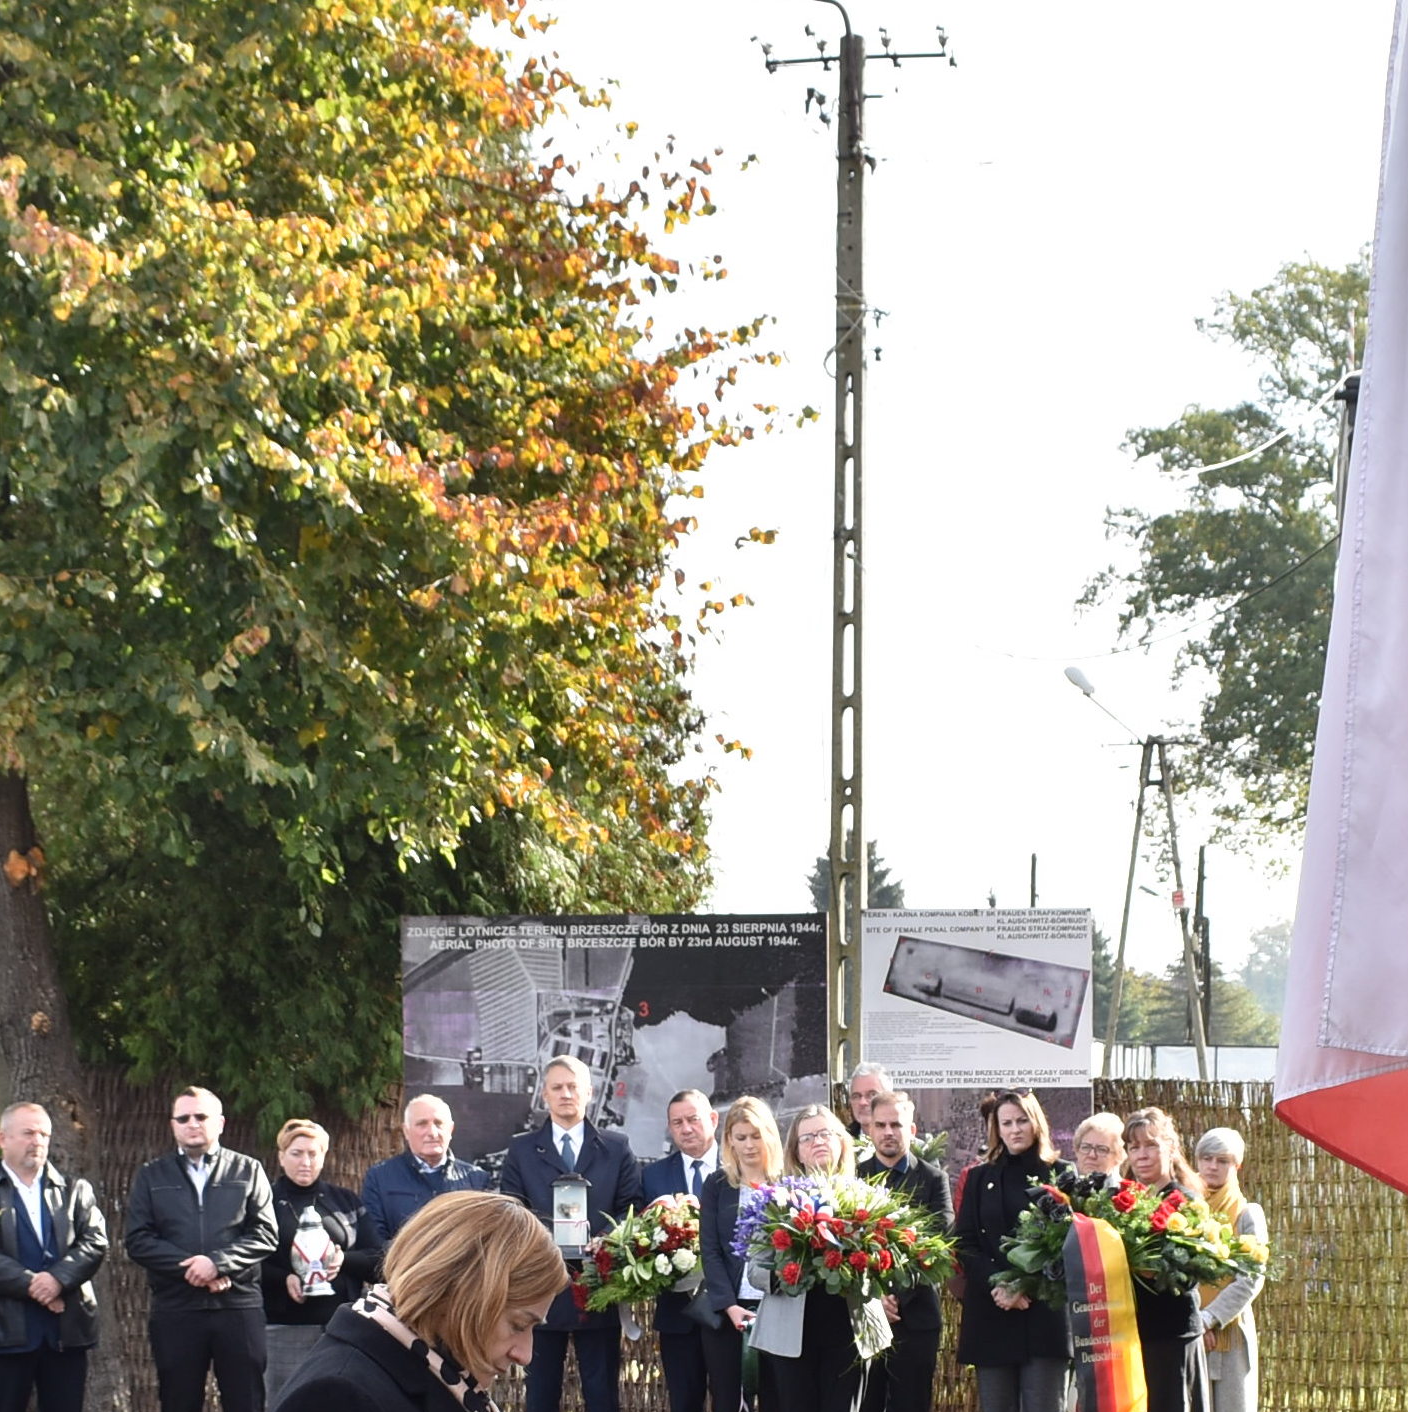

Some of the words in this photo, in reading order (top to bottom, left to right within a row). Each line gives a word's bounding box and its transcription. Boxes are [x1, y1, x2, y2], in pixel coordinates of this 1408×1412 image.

[407, 926, 456, 939] ZDJĘCIE
[459, 925, 516, 936] LOTNICZE
[519, 925, 567, 936] TERENU
[570, 923, 640, 936] BRZESZCZE
[642, 922, 668, 935] BÓR
[670, 923, 679, 934] Z
[681, 923, 711, 934] DNIA
[715, 923, 729, 934] 23
[732, 922, 787, 934] SIERPNIA
[790, 922, 823, 933] 1944r.
[429, 939, 473, 950] AERIAL
[475, 938, 516, 949] PHOTO
[519, 938, 536, 949] OF
[538, 938, 564, 949] SITE
[567, 937, 637, 948] BRZESZCZE
[639, 935, 666, 947] BÓR
[668, 936, 685, 947] BY
[687, 935, 712, 947] 23rd
[715, 935, 764, 947] AUGUST
[768, 935, 801, 946] 1944r.
[638, 1001, 650, 1017] 3
[897, 1069, 943, 1077] SATELITARNE
[945, 1069, 974, 1077] TERENU
[1017, 1067, 1033, 1076] BÓR
[1059, 1068, 1088, 1076] OBECNE
[614, 1081, 626, 1097] 2
[1089, 1281, 1103, 1294] Der
[1093, 1316, 1106, 1328] der
